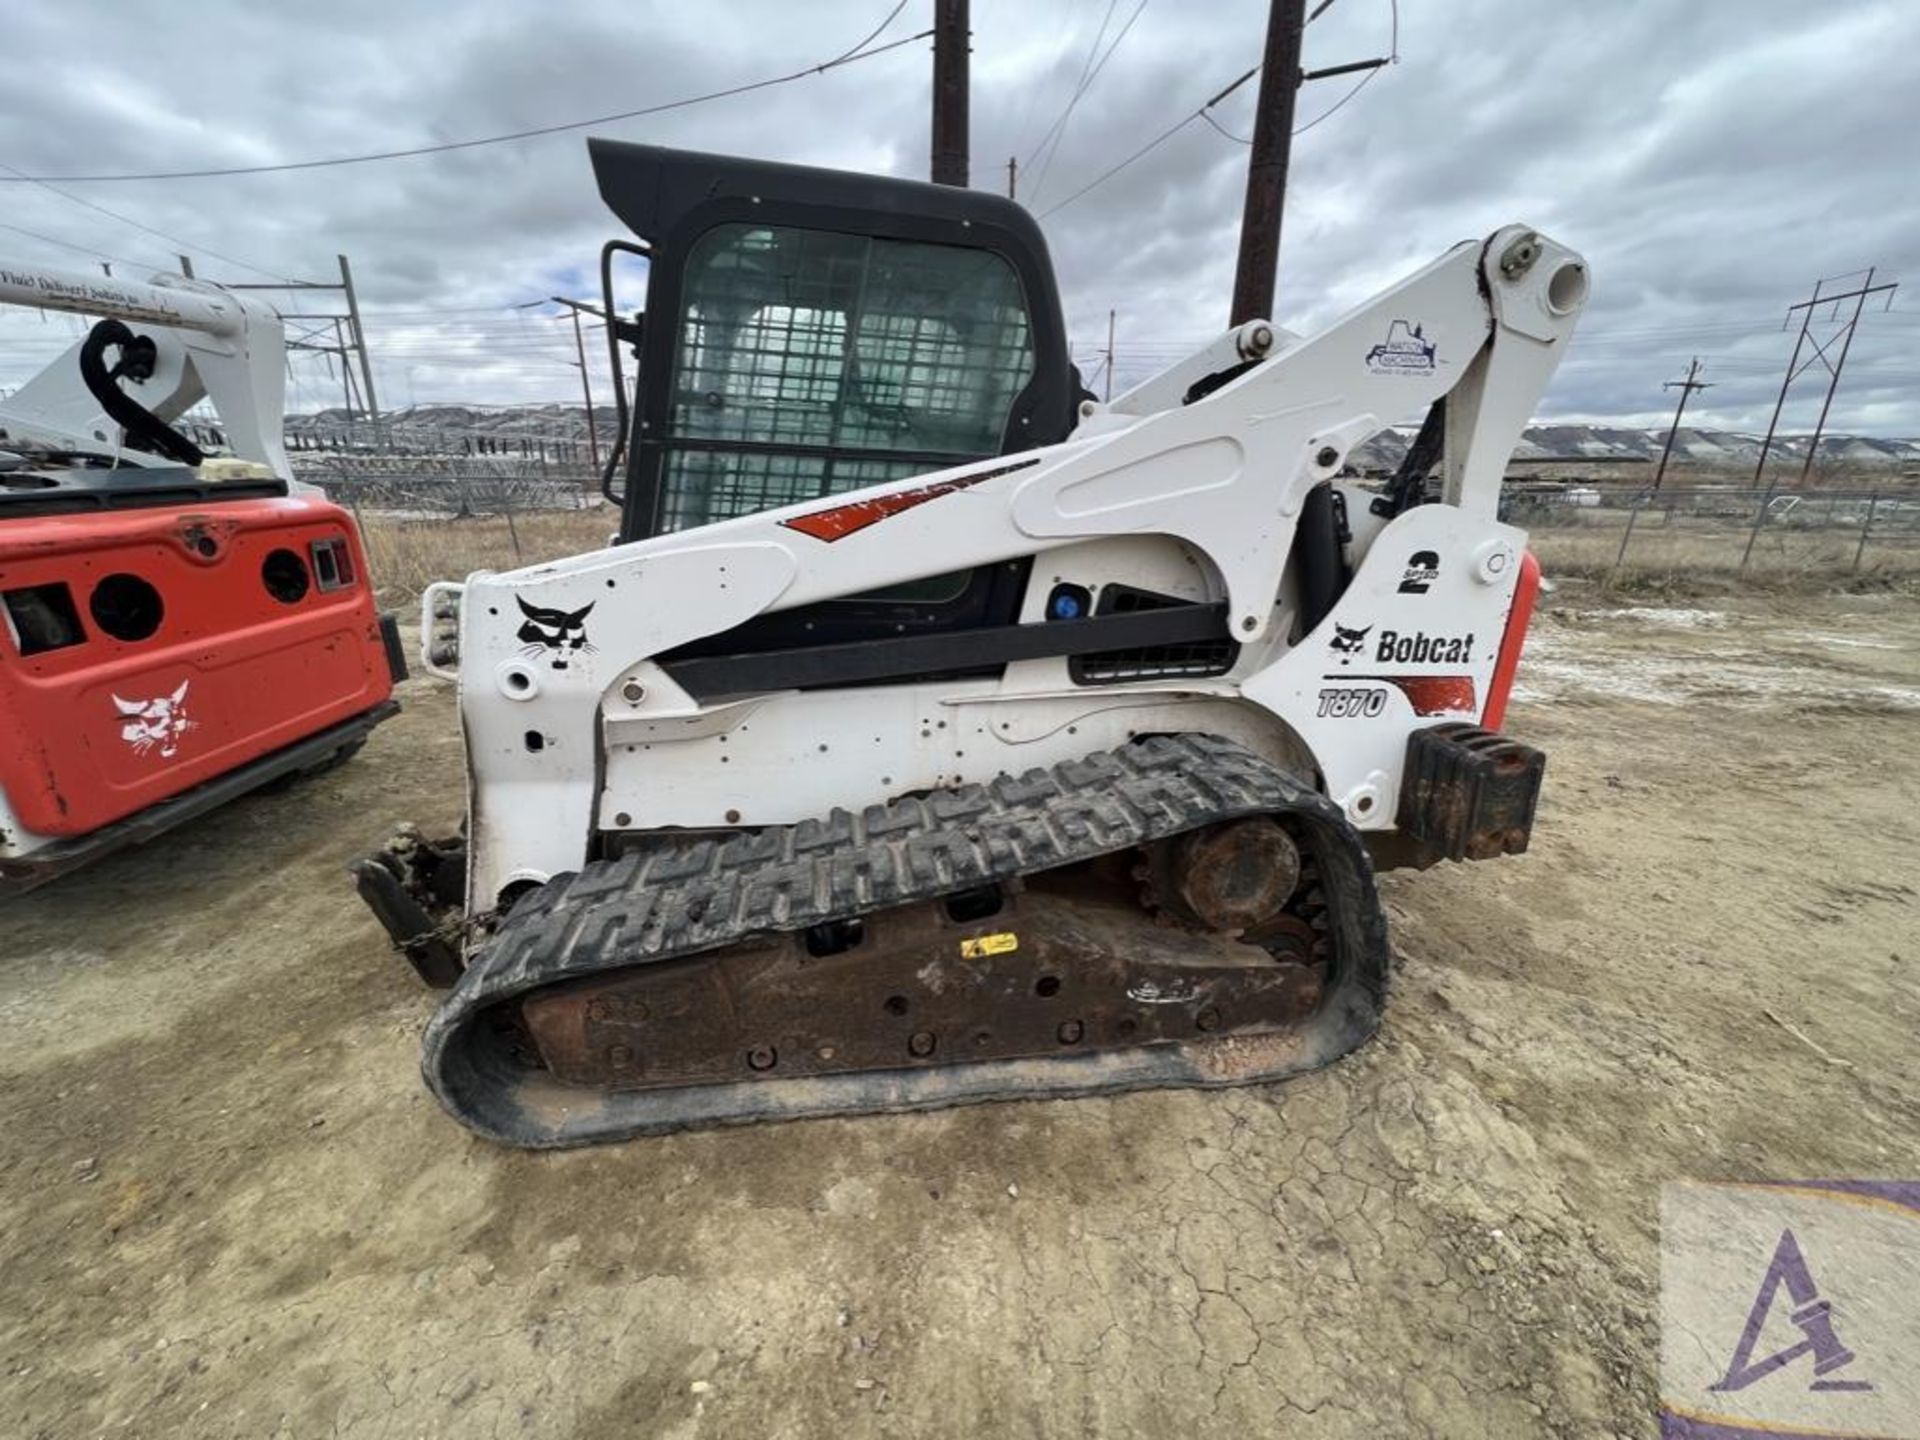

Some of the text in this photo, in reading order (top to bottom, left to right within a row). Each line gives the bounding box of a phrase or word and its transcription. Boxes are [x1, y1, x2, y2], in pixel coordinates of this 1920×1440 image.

[1397, 550, 1439, 594] 2
[1376, 631, 1474, 664] Bobcat
[1317, 689, 1388, 717] T870
